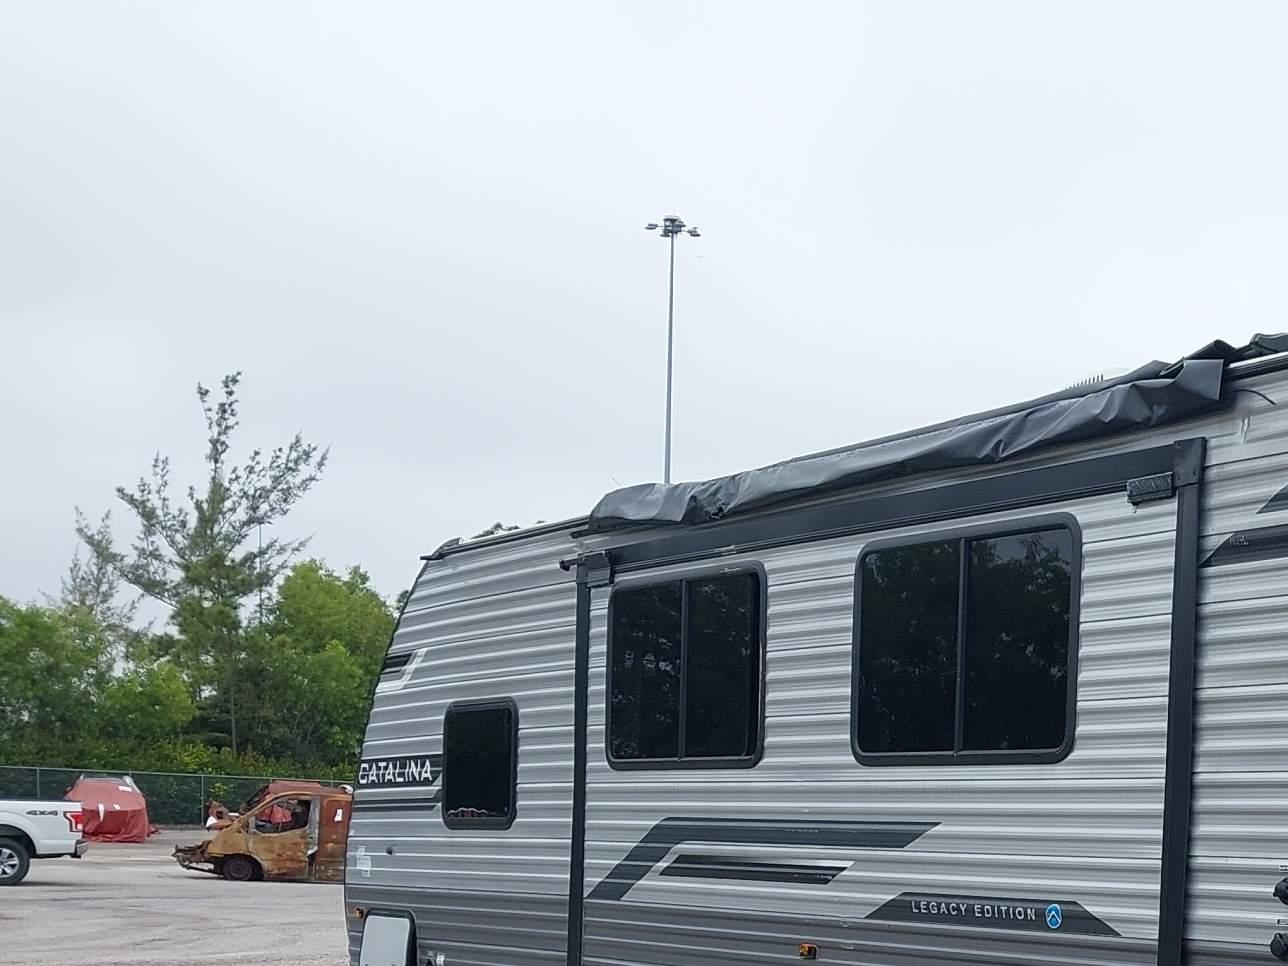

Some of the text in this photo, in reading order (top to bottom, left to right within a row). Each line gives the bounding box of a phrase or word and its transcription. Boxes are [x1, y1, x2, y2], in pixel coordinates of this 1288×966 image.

[359, 759, 432, 784] CATALINA
[911, 900, 1036, 920] LEGACY EDITION
